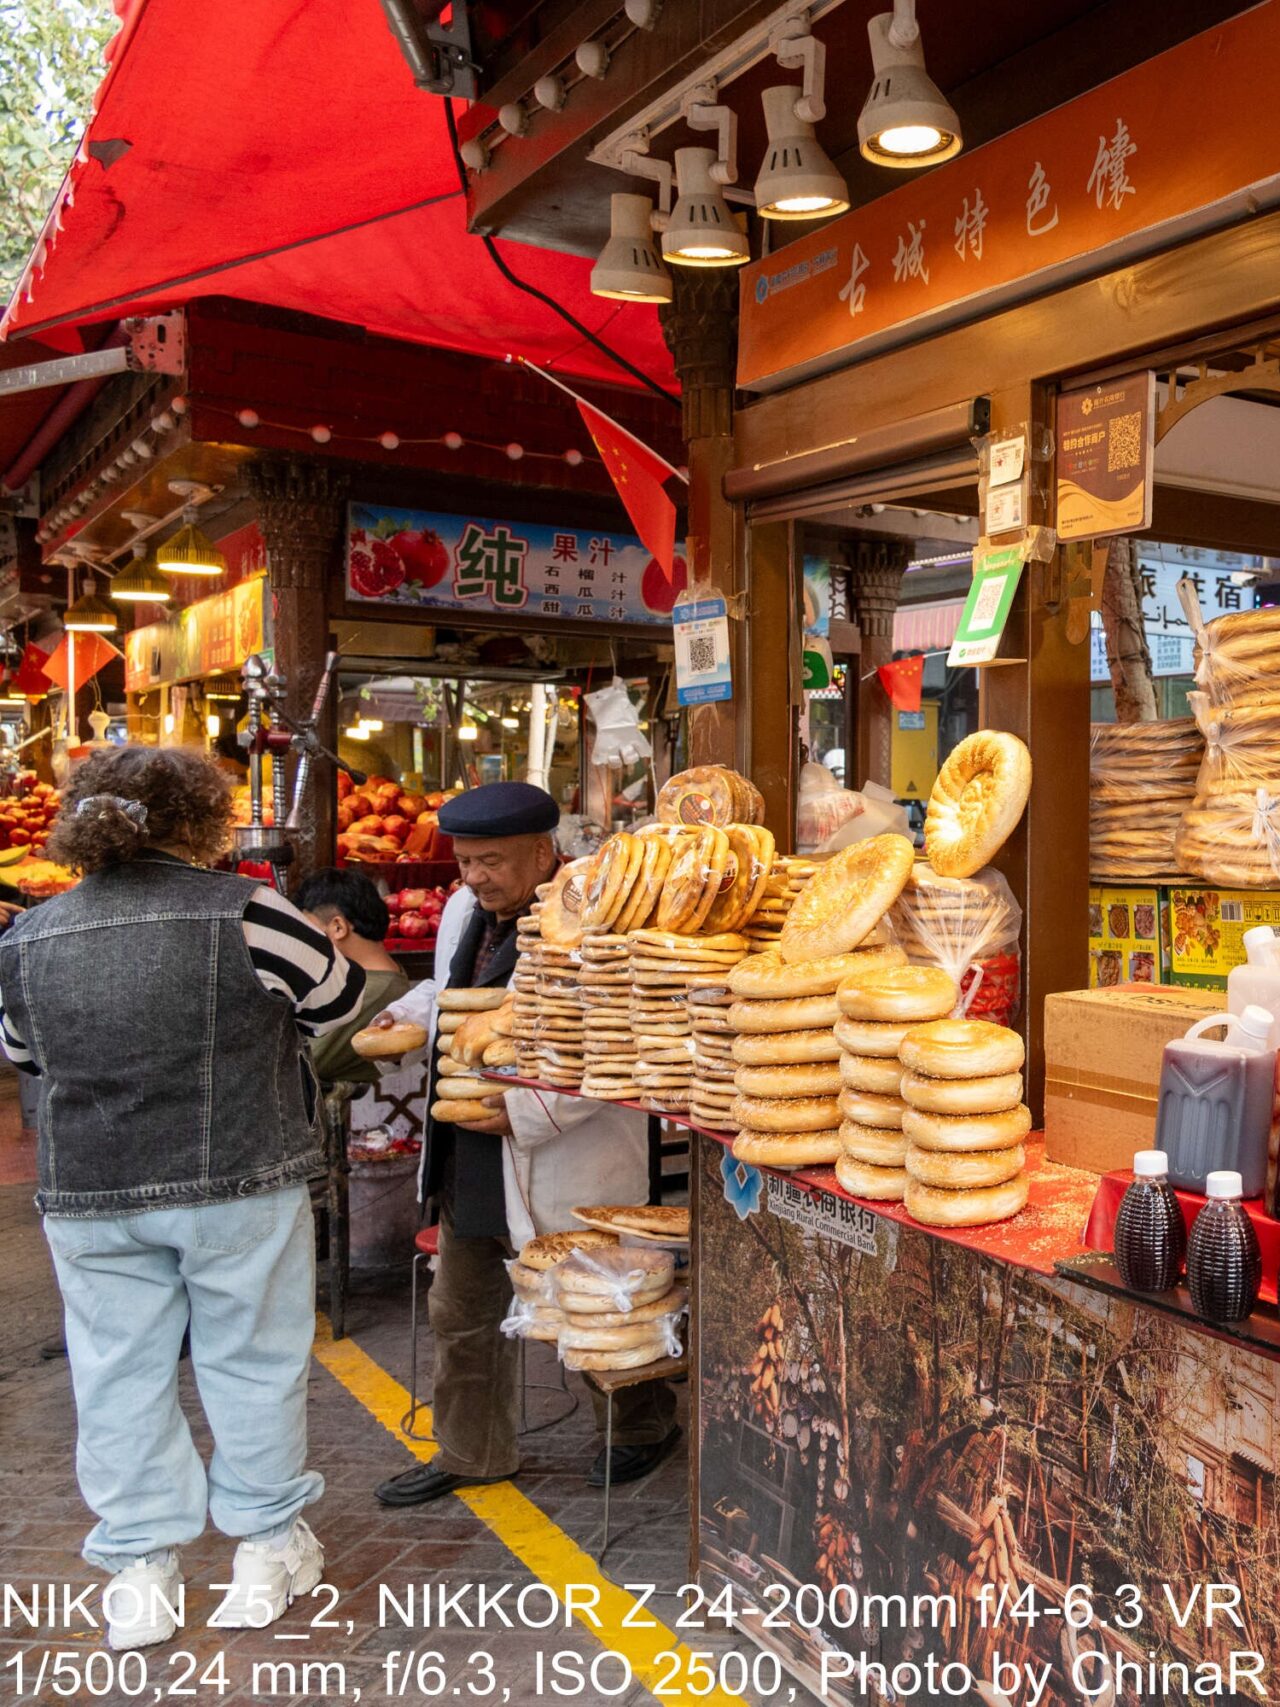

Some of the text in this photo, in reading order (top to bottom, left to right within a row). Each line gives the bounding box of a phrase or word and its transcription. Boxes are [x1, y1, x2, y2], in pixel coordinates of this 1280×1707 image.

[839, 117, 1137, 317] 古城特色馕
[455, 524, 528, 607] 纯
[553, 533, 615, 567] 果汁
[544, 564, 627, 585] 石榴汁
[544, 583, 627, 602] 西瓜汁
[543, 601, 626, 619] 甜瓜汁
[768, 1199, 876, 1251] Xinjiang Rural Commercial Bank
